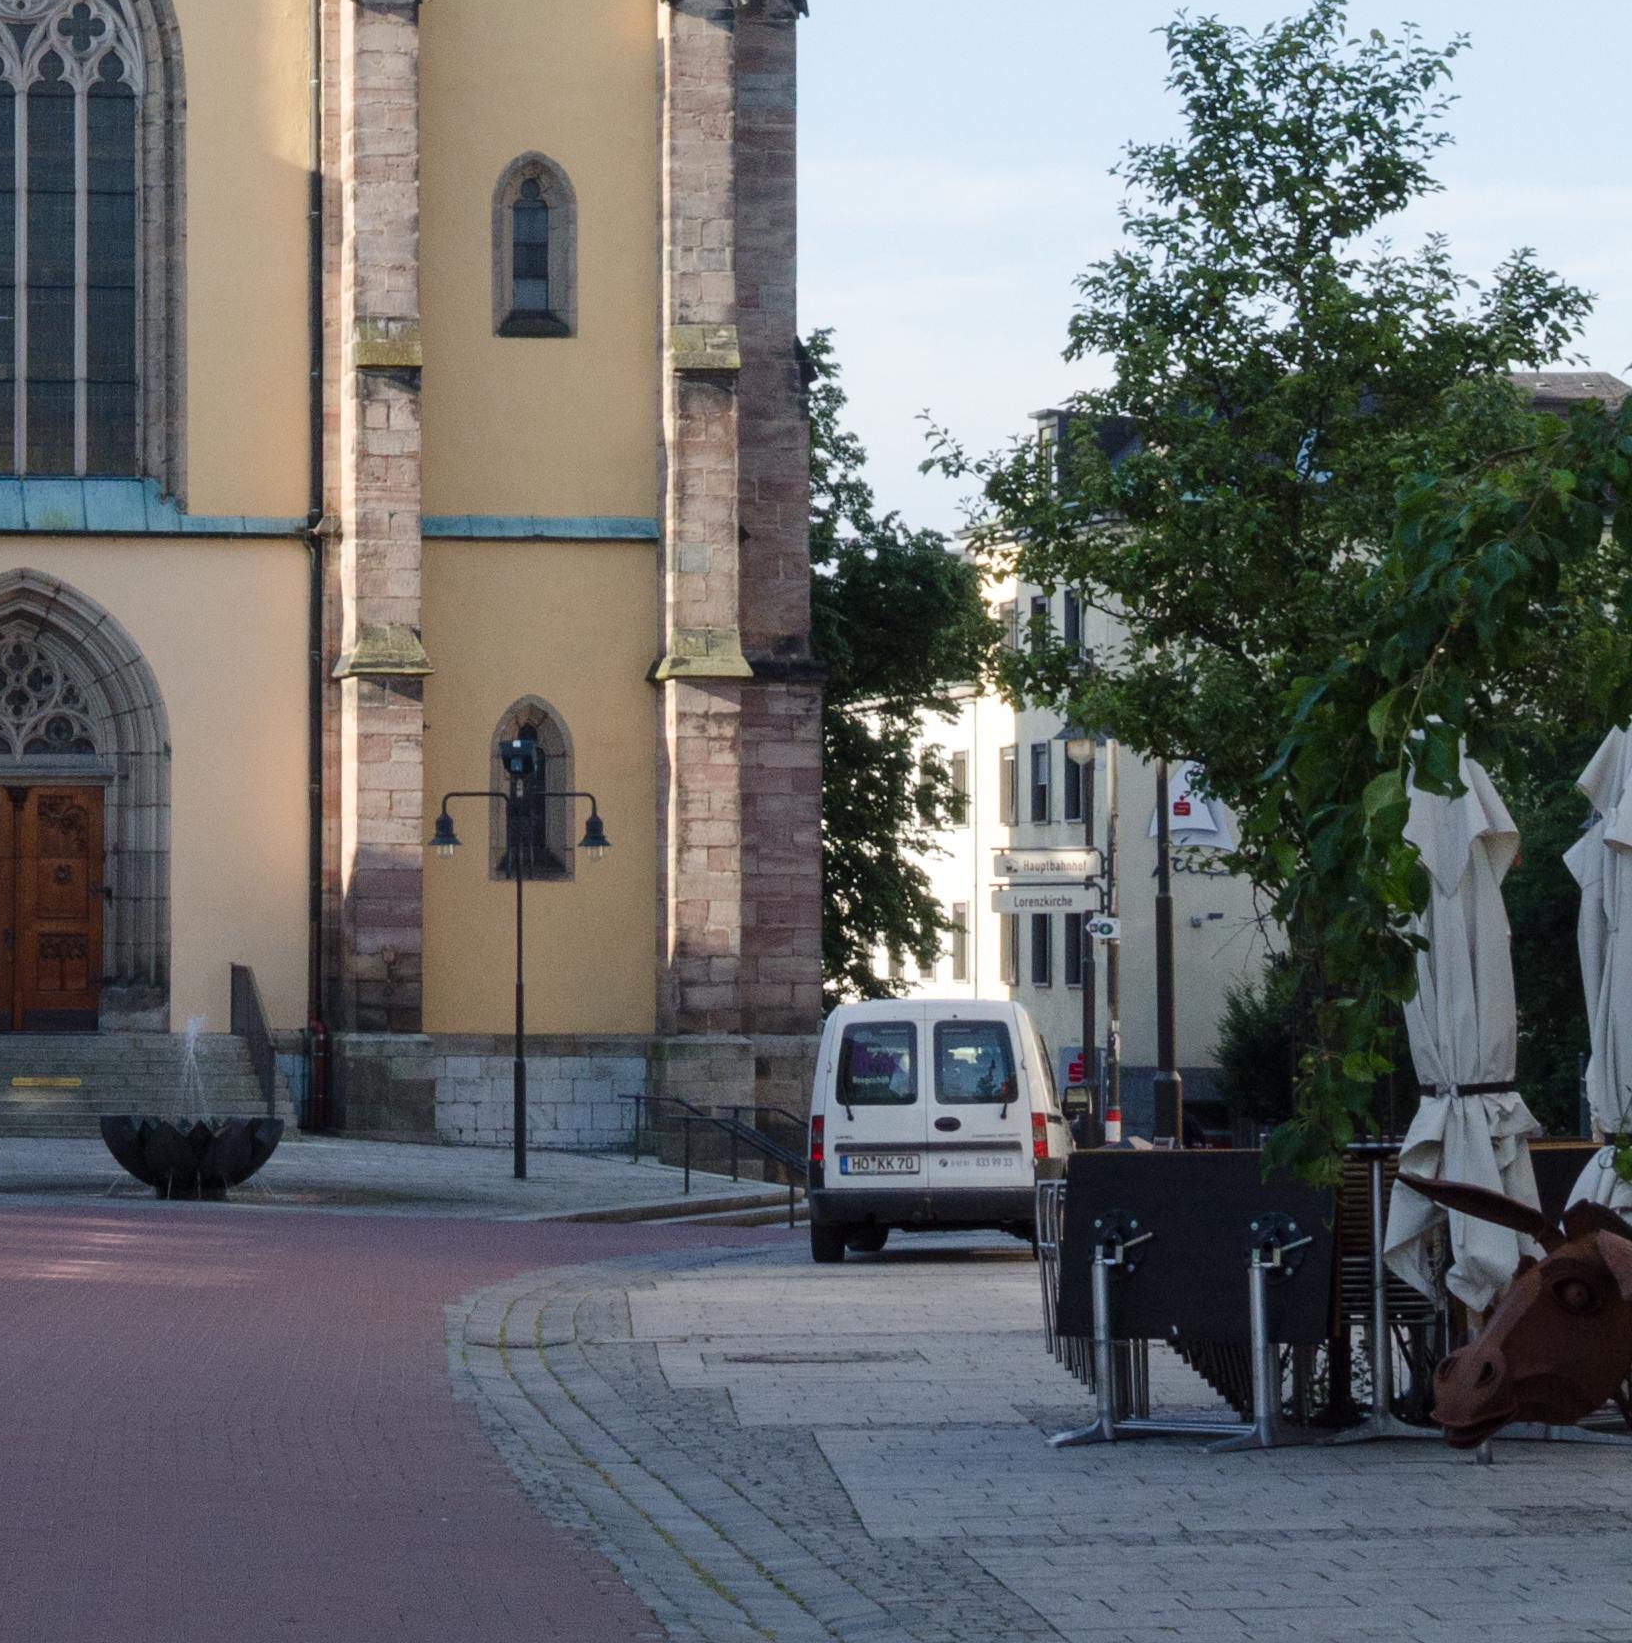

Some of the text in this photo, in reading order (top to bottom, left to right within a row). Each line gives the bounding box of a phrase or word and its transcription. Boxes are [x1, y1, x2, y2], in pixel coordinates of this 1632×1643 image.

[1023, 859, 1087, 874] Hauptbahnhof
[1014, 896, 1074, 908] Lorenzkirche
[877, 1157, 895, 1170] KK
[897, 1157, 914, 1170] 70
